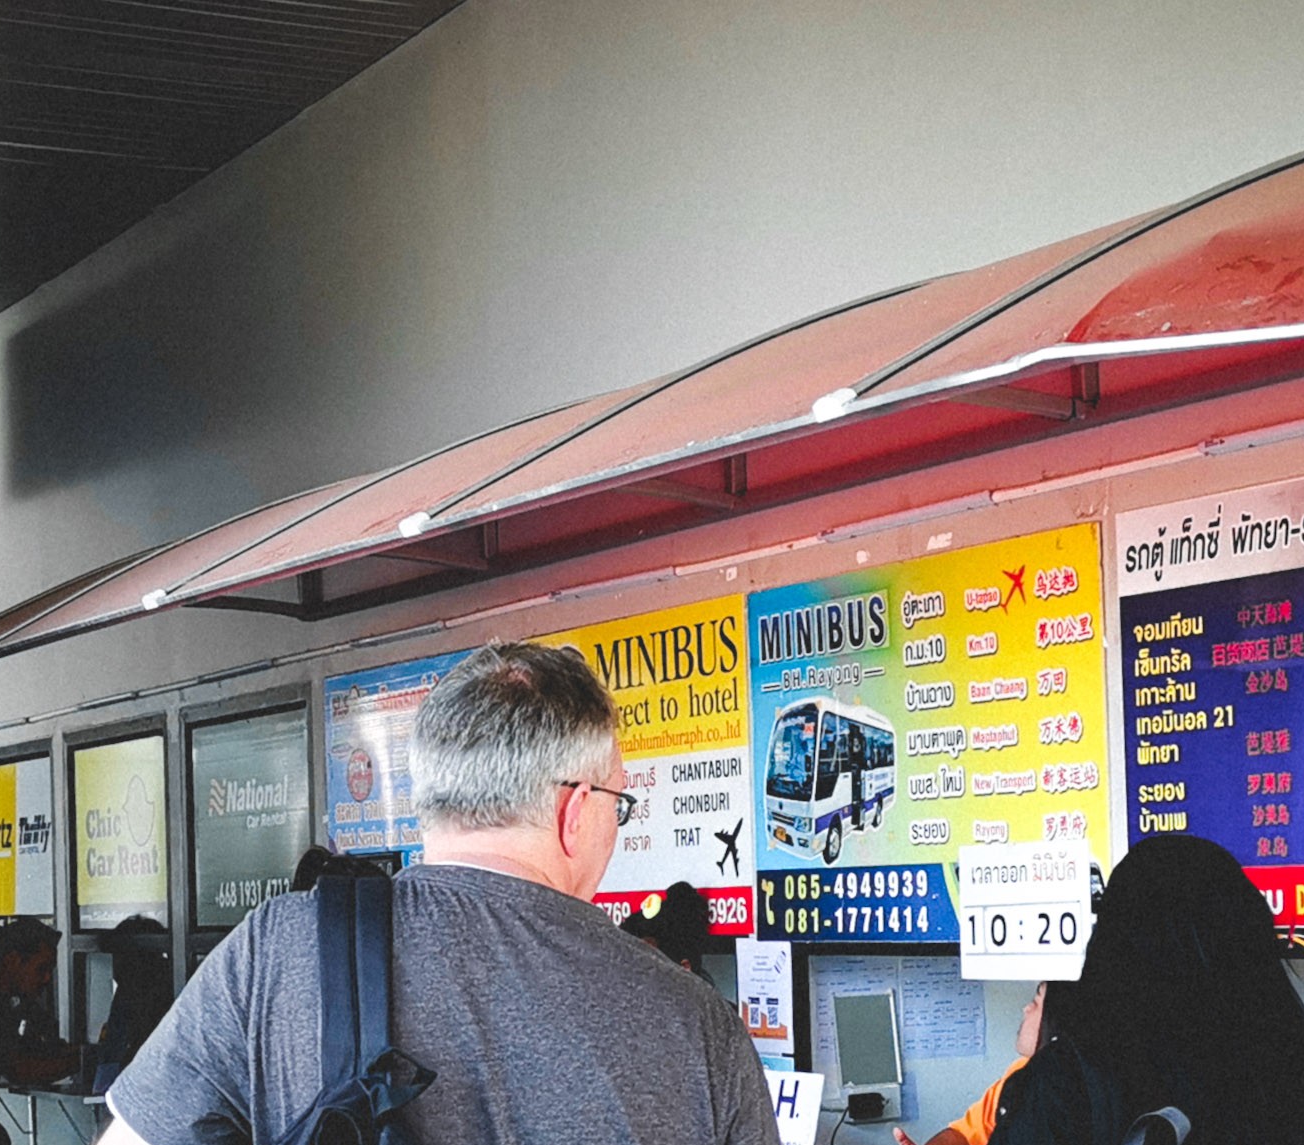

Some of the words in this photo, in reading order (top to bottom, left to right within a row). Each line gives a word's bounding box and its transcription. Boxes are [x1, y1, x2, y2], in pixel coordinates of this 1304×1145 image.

[1125, 526, 1166, 582] รถตู้
[760, 595, 886, 663] MINIBUS
[594, 616, 738, 692] MINIBUS
[617, 697, 650, 729] rect
[660, 694, 679, 723] to
[688, 677, 740, 718] hotel
[1213, 705, 1234, 728] 21
[671, 757, 742, 783] CHANTABURI
[224, 775, 289, 814] National
[673, 792, 730, 816] CHONBURI
[86, 809, 121, 840] Chic
[673, 827, 701, 847] TRAT
[87, 849, 113, 878] Car
[117, 845, 159, 876] Rent
[784, 869, 928, 900] 065-4949939
[784, 906, 929, 933] 081-1771414
[968, 912, 1077, 947] 10:20
